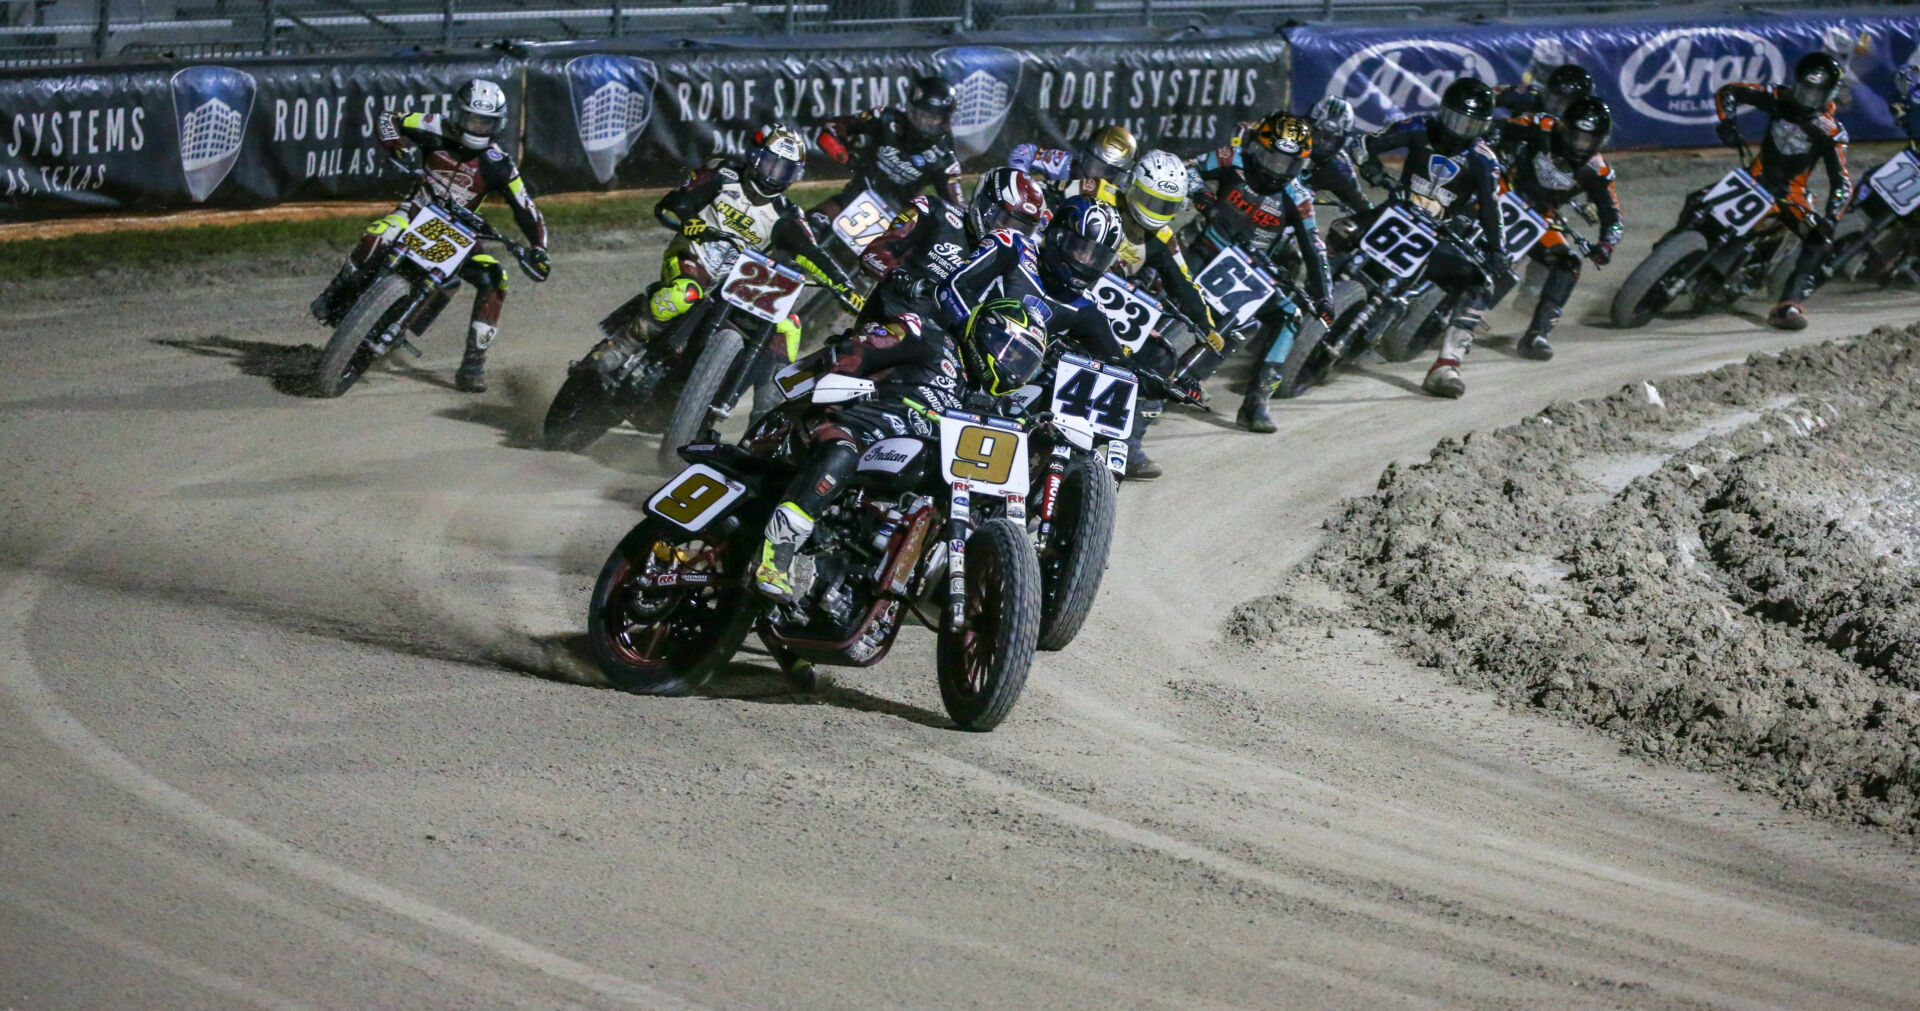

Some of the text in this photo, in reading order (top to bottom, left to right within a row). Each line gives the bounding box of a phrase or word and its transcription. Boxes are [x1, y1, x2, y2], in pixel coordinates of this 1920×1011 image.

[1039, 68, 1258, 110] ROOF SYSTEMS
[1632, 37, 1767, 97] Arai
[273, 96, 347, 142] ROOF
[677, 76, 909, 122] ROOF SYSTEMS
[1668, 100, 1716, 111] HELM
[8, 106, 145, 158] SYSTEMS
[1065, 114, 1217, 142] DAAS, TEXAS
[40, 163, 107, 193] TEXAS
[306, 149, 384, 178] DALLAS,
[1158, 181, 1179, 193] Arai
[1227, 189, 1280, 227] Briggs
[1708, 178, 1766, 227] 79
[717, 201, 755, 229] HITE
[402, 217, 473, 263] 5
[927, 250, 957, 273] MOTORCY
[1365, 216, 1436, 271] 62
[723, 260, 799, 315] 27
[927, 262, 949, 280] PROG
[1200, 255, 1266, 313] 67
[1098, 286, 1150, 342] 23
[944, 362, 955, 375] BELL
[1056, 368, 1134, 431] 44
[863, 445, 908, 465] Indian
[950, 425, 1020, 485] 9
[655, 472, 729, 524] 9
